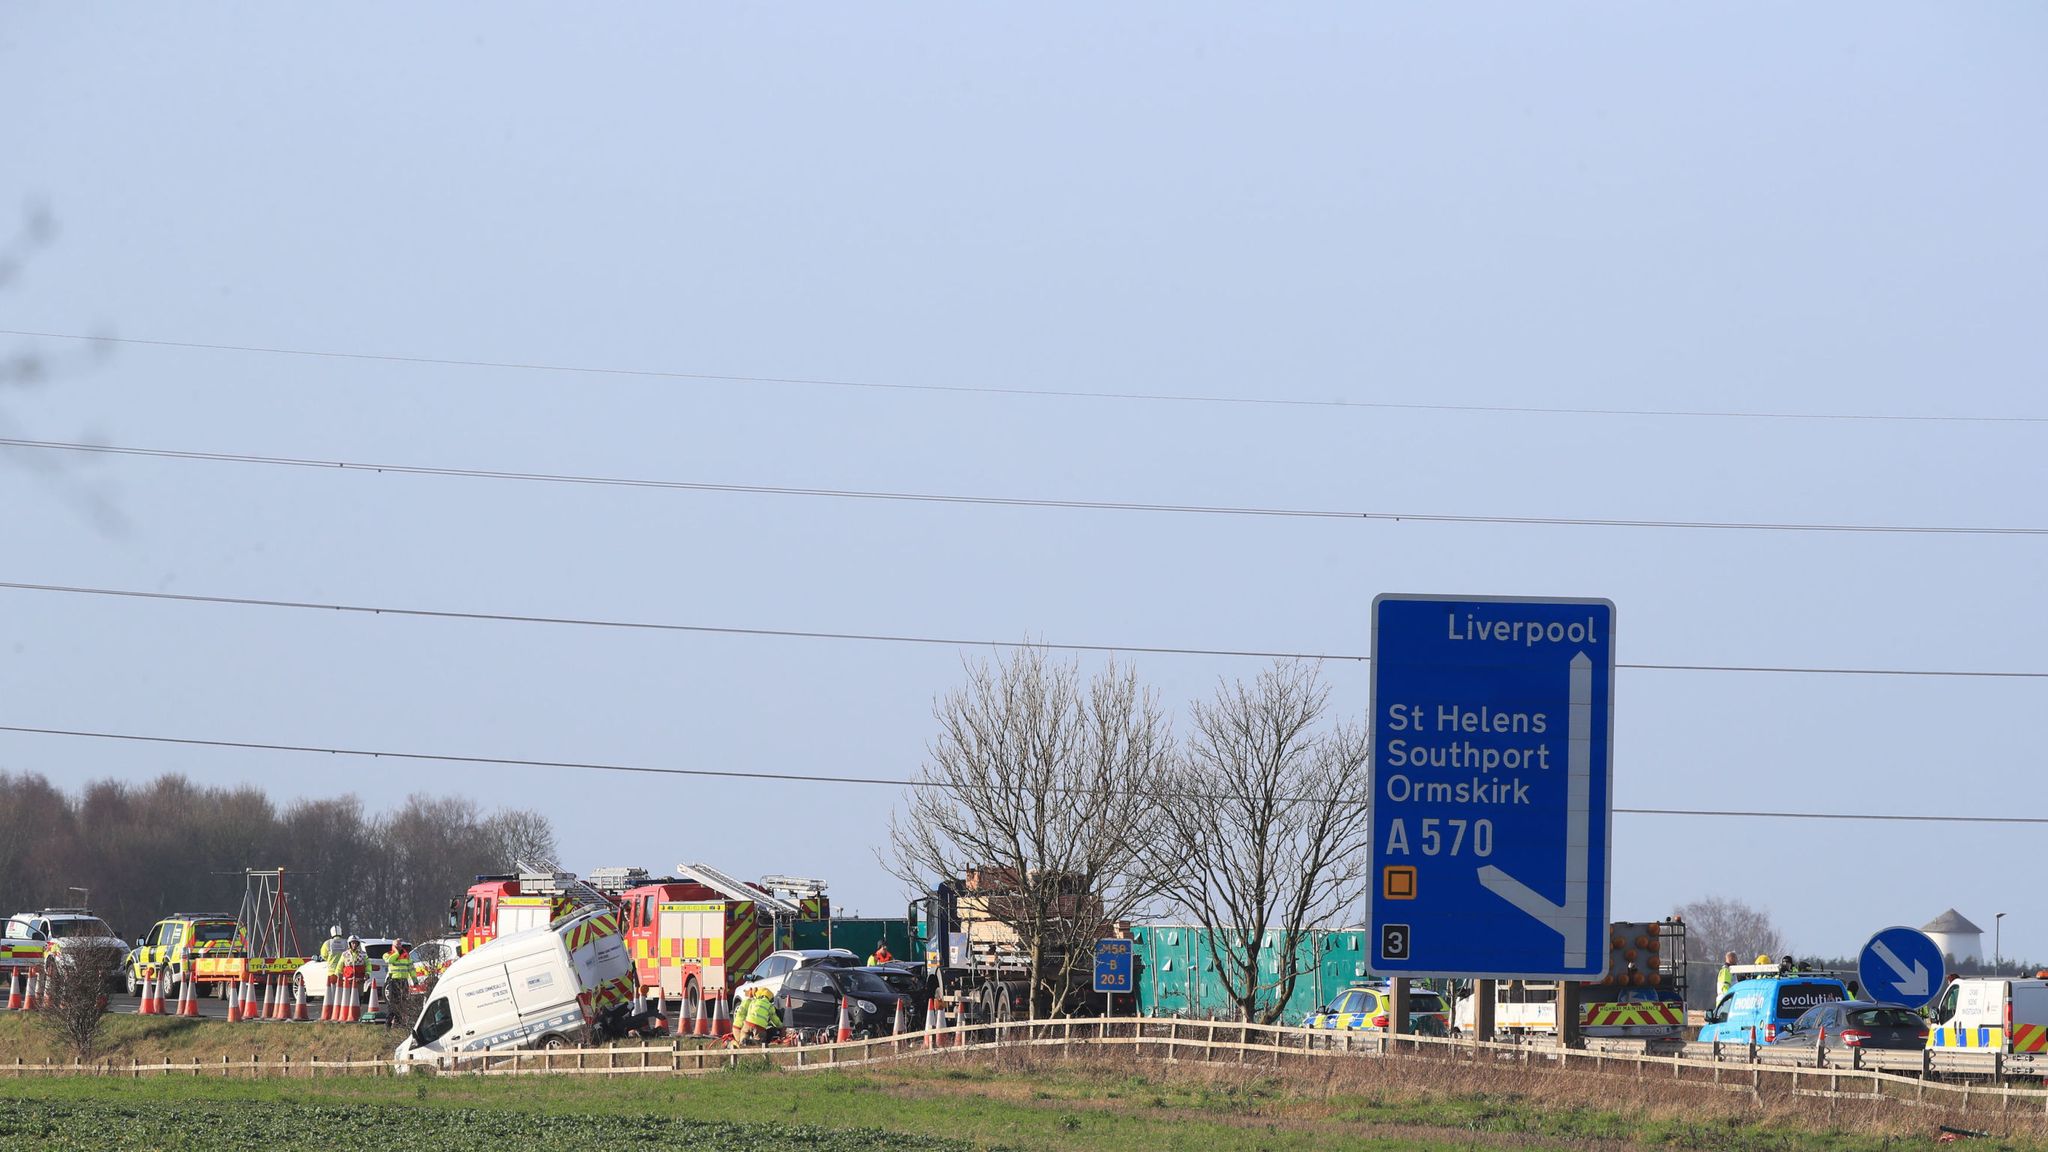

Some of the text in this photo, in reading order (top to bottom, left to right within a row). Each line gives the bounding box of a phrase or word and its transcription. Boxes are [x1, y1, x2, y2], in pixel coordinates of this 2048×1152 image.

[1448, 613, 1597, 647] Liverpool
[1388, 704, 1547, 733] St Helens
[1388, 739, 1550, 773] Southport
[1386, 775, 1530, 804] Ormskirk
[1388, 931, 1403, 954] 3
[1101, 974, 1125, 985] 20.5
